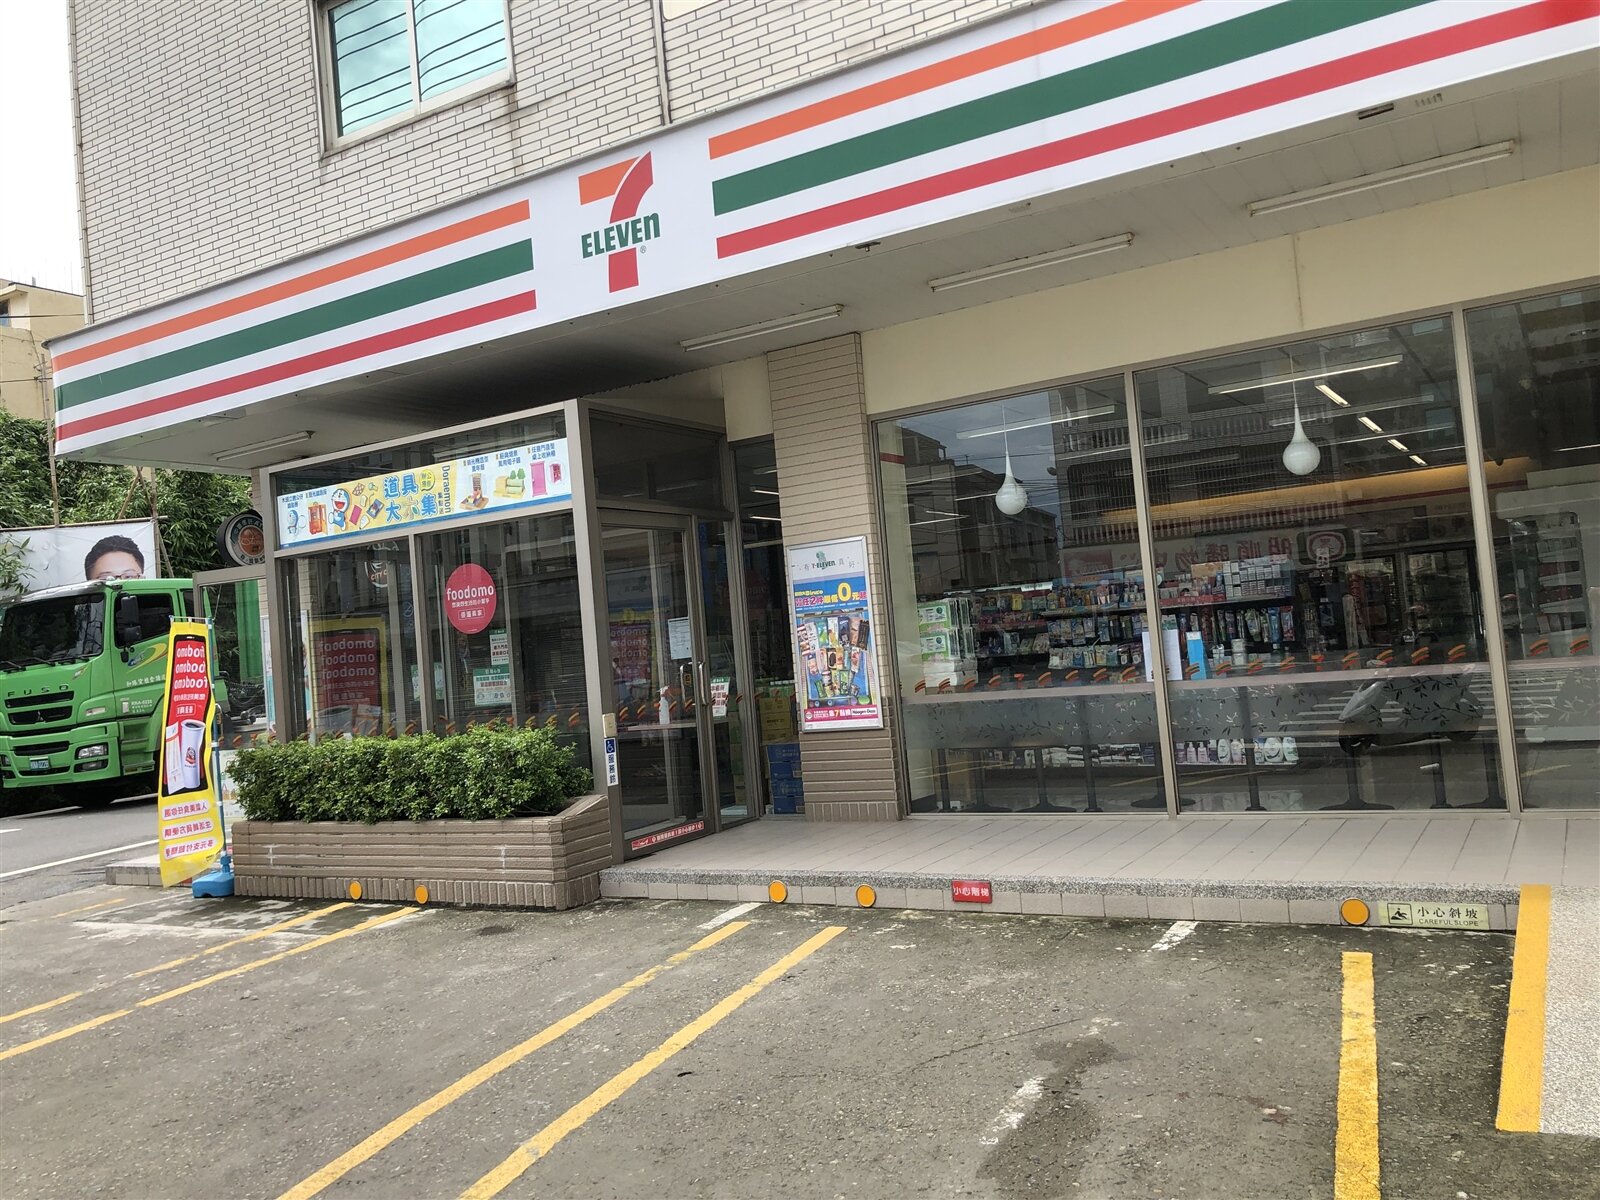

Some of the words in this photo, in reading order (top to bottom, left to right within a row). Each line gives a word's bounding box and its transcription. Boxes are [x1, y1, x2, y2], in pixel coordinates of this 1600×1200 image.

[384, 472, 418, 499] 道具
[441, 465, 451, 513] Doraemon
[446, 584, 494, 601] foodomo
[319, 638, 375, 653] foodomo
[320, 651, 376, 666] foodomo
[322, 665, 376, 680] foodomo
[7, 684, 70, 698] FUSO
[953, 886, 990, 897] 小心階梯
[1417, 906, 1478, 919] 小心斜坡
[1418, 918, 1454, 926] CAREFUL
[1454, 919, 1479, 927] SLOPE
